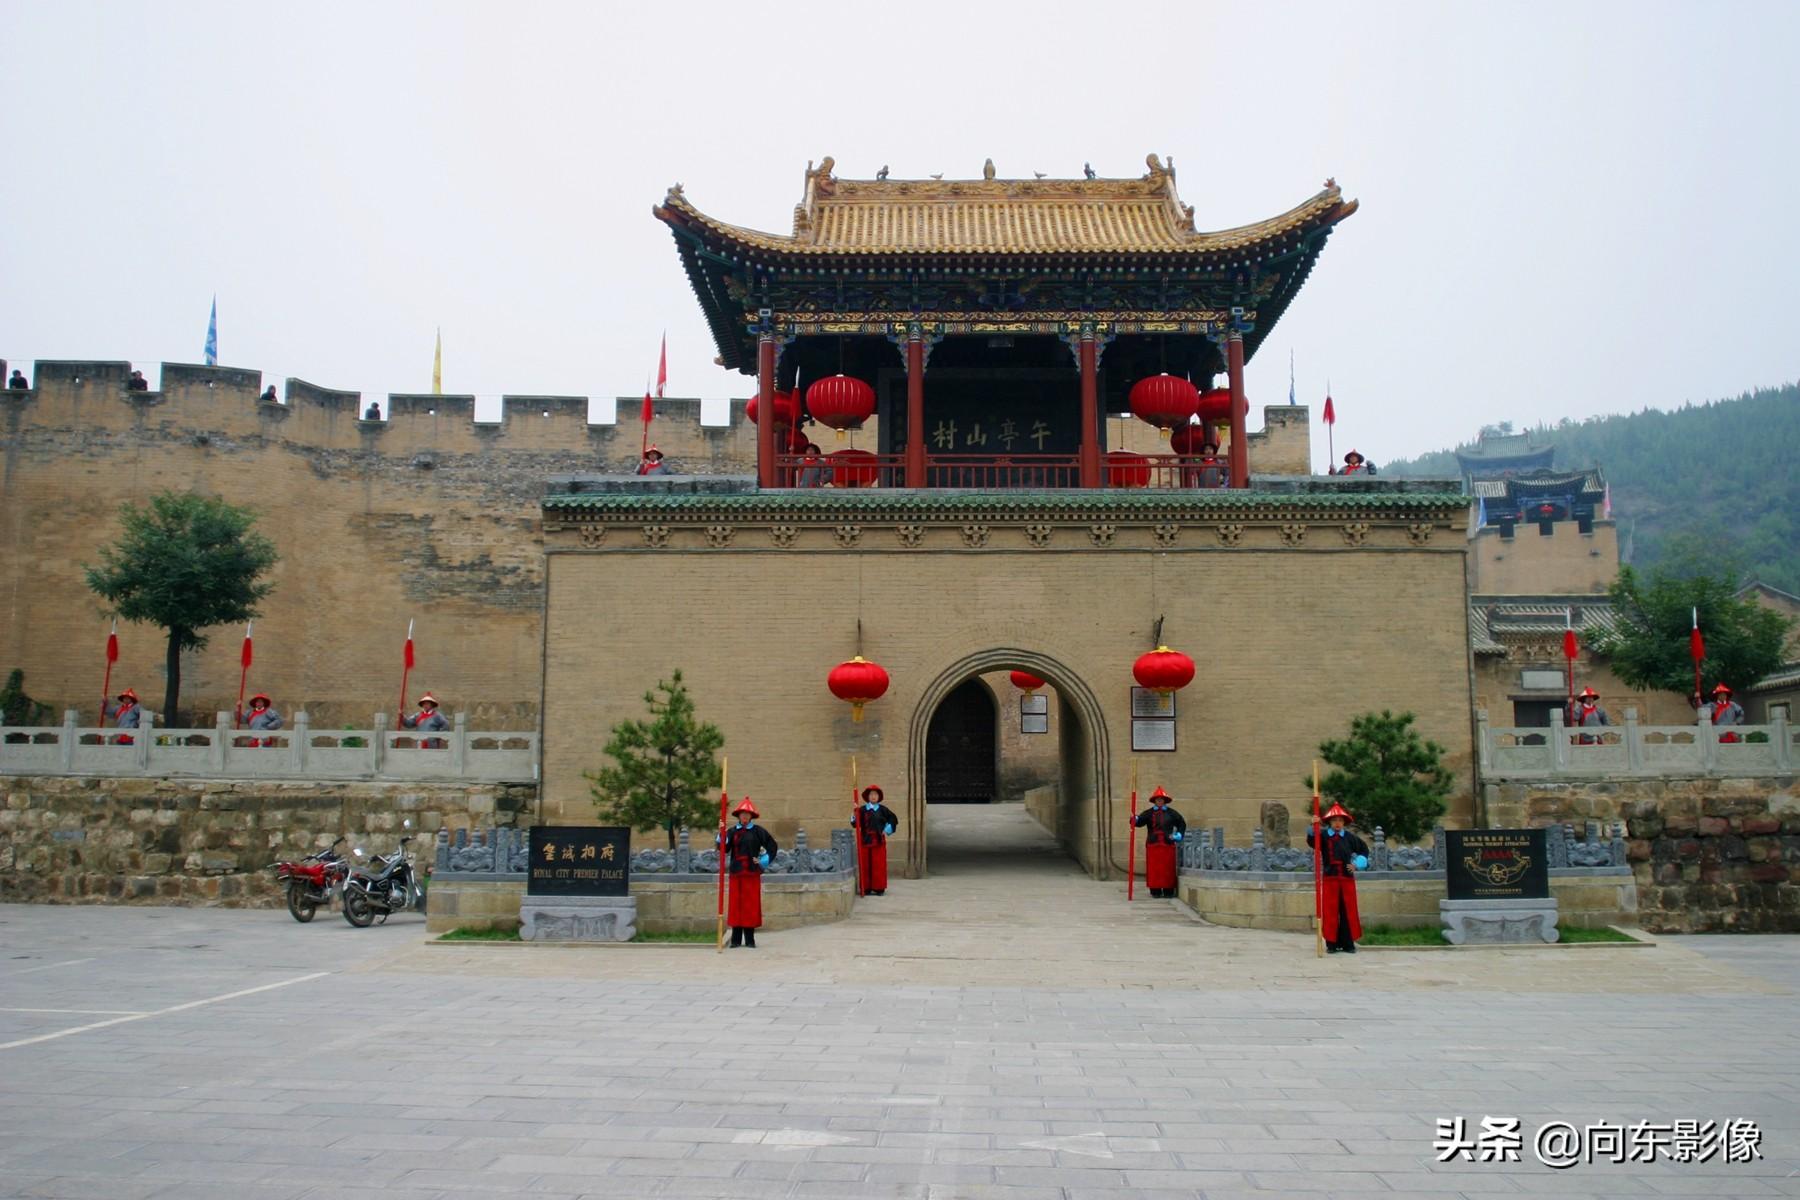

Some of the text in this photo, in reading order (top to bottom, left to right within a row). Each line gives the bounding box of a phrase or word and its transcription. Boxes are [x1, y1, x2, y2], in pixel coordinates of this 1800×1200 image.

[543, 842, 615, 862] 皇城相府
[555, 868, 570, 878] CITY
[601, 869, 624, 879] PALACE
